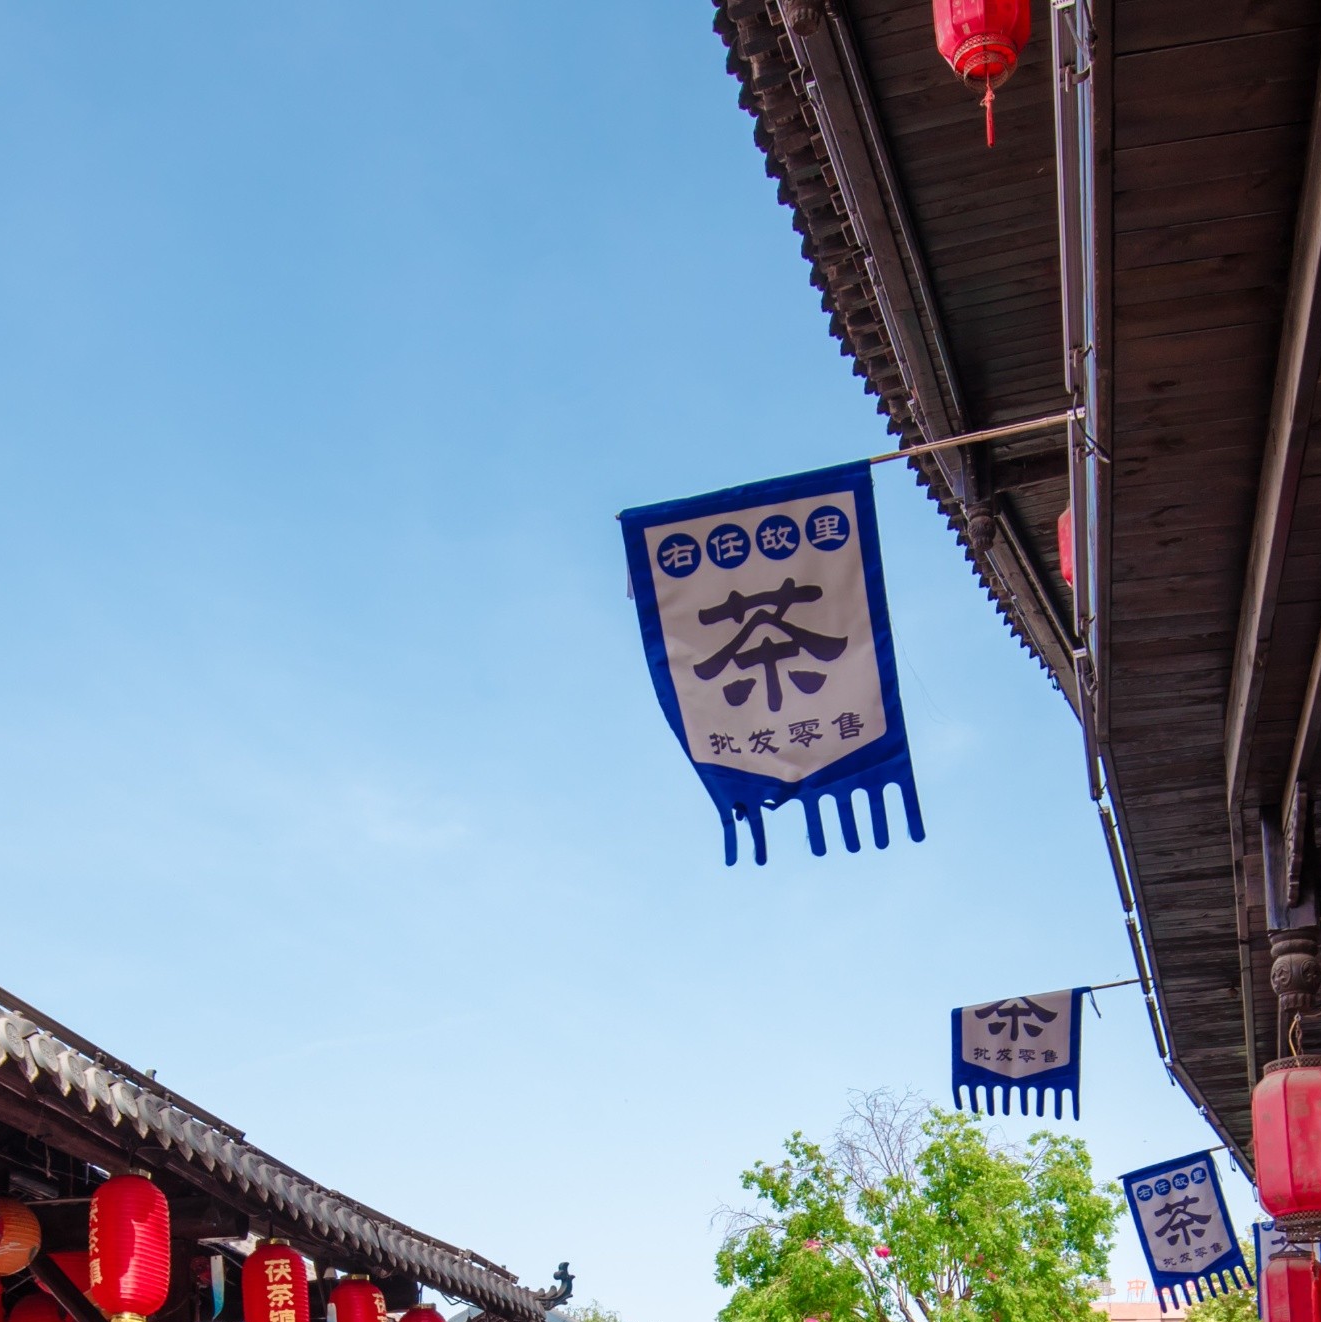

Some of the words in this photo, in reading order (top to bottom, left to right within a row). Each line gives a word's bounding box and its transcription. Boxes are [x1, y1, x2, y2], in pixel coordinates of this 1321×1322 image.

[659, 511, 847, 571] 右任故里
[693, 577, 849, 712] 茶
[709, 710, 866, 757] 批发零售
[974, 1046, 1059, 1064] 批发零售
[1137, 1168, 1207, 1201] 右任故里
[1154, 1195, 1212, 1247] 茶
[1163, 1241, 1225, 1268] 批发零售
